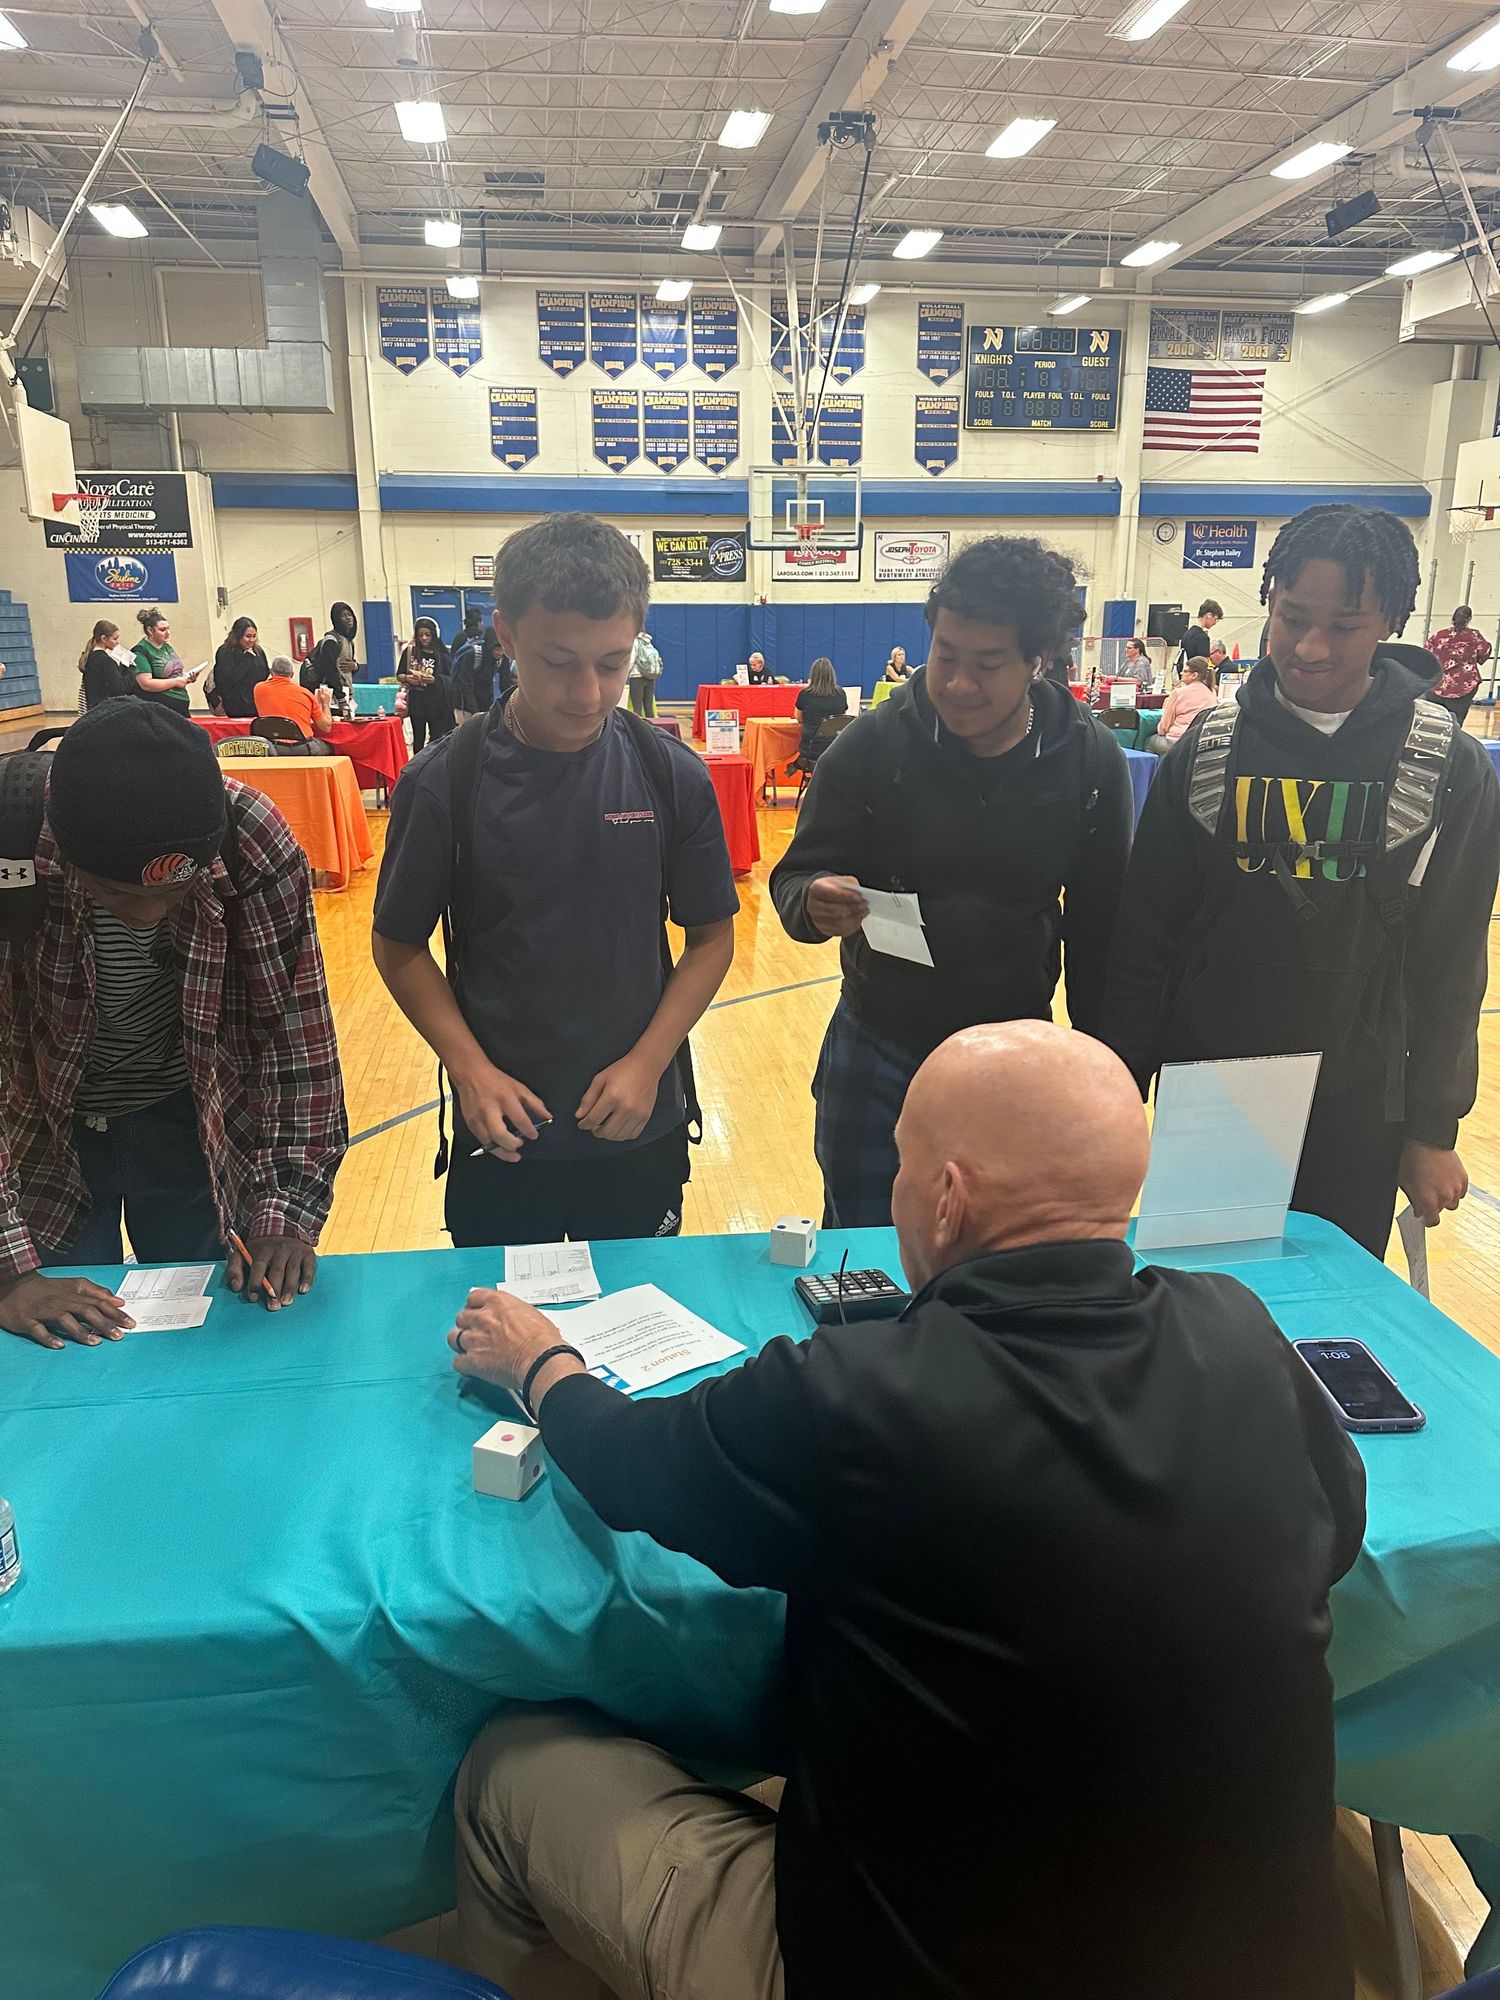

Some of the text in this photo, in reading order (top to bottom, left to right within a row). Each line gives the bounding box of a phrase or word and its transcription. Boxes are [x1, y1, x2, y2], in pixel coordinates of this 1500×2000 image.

[380, 293, 426, 304] CHAMPIONS
[539, 297, 583, 307] CHAMPIONS
[591, 299, 635, 309] CHAMPIONS
[642, 300, 686, 310] CHAMPIONS
[693, 301, 736, 311] CHAMPIONS
[920, 309, 961, 318] CHAMPIONS
[1151, 324, 1182, 341] FINAL
[1224, 325, 1289, 344] FINAL FOUR
[983, 328, 1003, 350] N
[1090, 331, 1110, 353] N
[1167, 343, 1195, 357] 2000
[1242, 345, 1269, 358] 2003
[975, 354, 1013, 365] KNIGHTS
[1082, 357, 1110, 367] GUEST
[491, 393, 536, 403] CHAMPIONS
[594, 396, 638, 405] CHAMPIONS
[645, 397, 688, 406] CHAMPIONS
[695, 397, 737, 407] CHAMPIONS
[822, 400, 862, 409] CHAMPIONS
[917, 402, 958, 410] CHAMPIONS
[76, 479, 154, 496] NovaCare
[1209, 524, 1248, 538] Health
[656, 540, 708, 552] WE CAN DO IT.
[909, 543, 936, 555] TOYOTA
[710, 548, 744, 565] EXPRESS
[1204, 549, 1225, 558] Stephen
[1226, 549, 1241, 558] Dailey
[667, 558, 704, 566] 728-3344
[105, 568, 141, 583] Skyline
[218, 740, 269, 757] NORTHWEST
[652, 1349, 691, 1367] Station
[1321, 1351, 1351, 1359] 1:08
